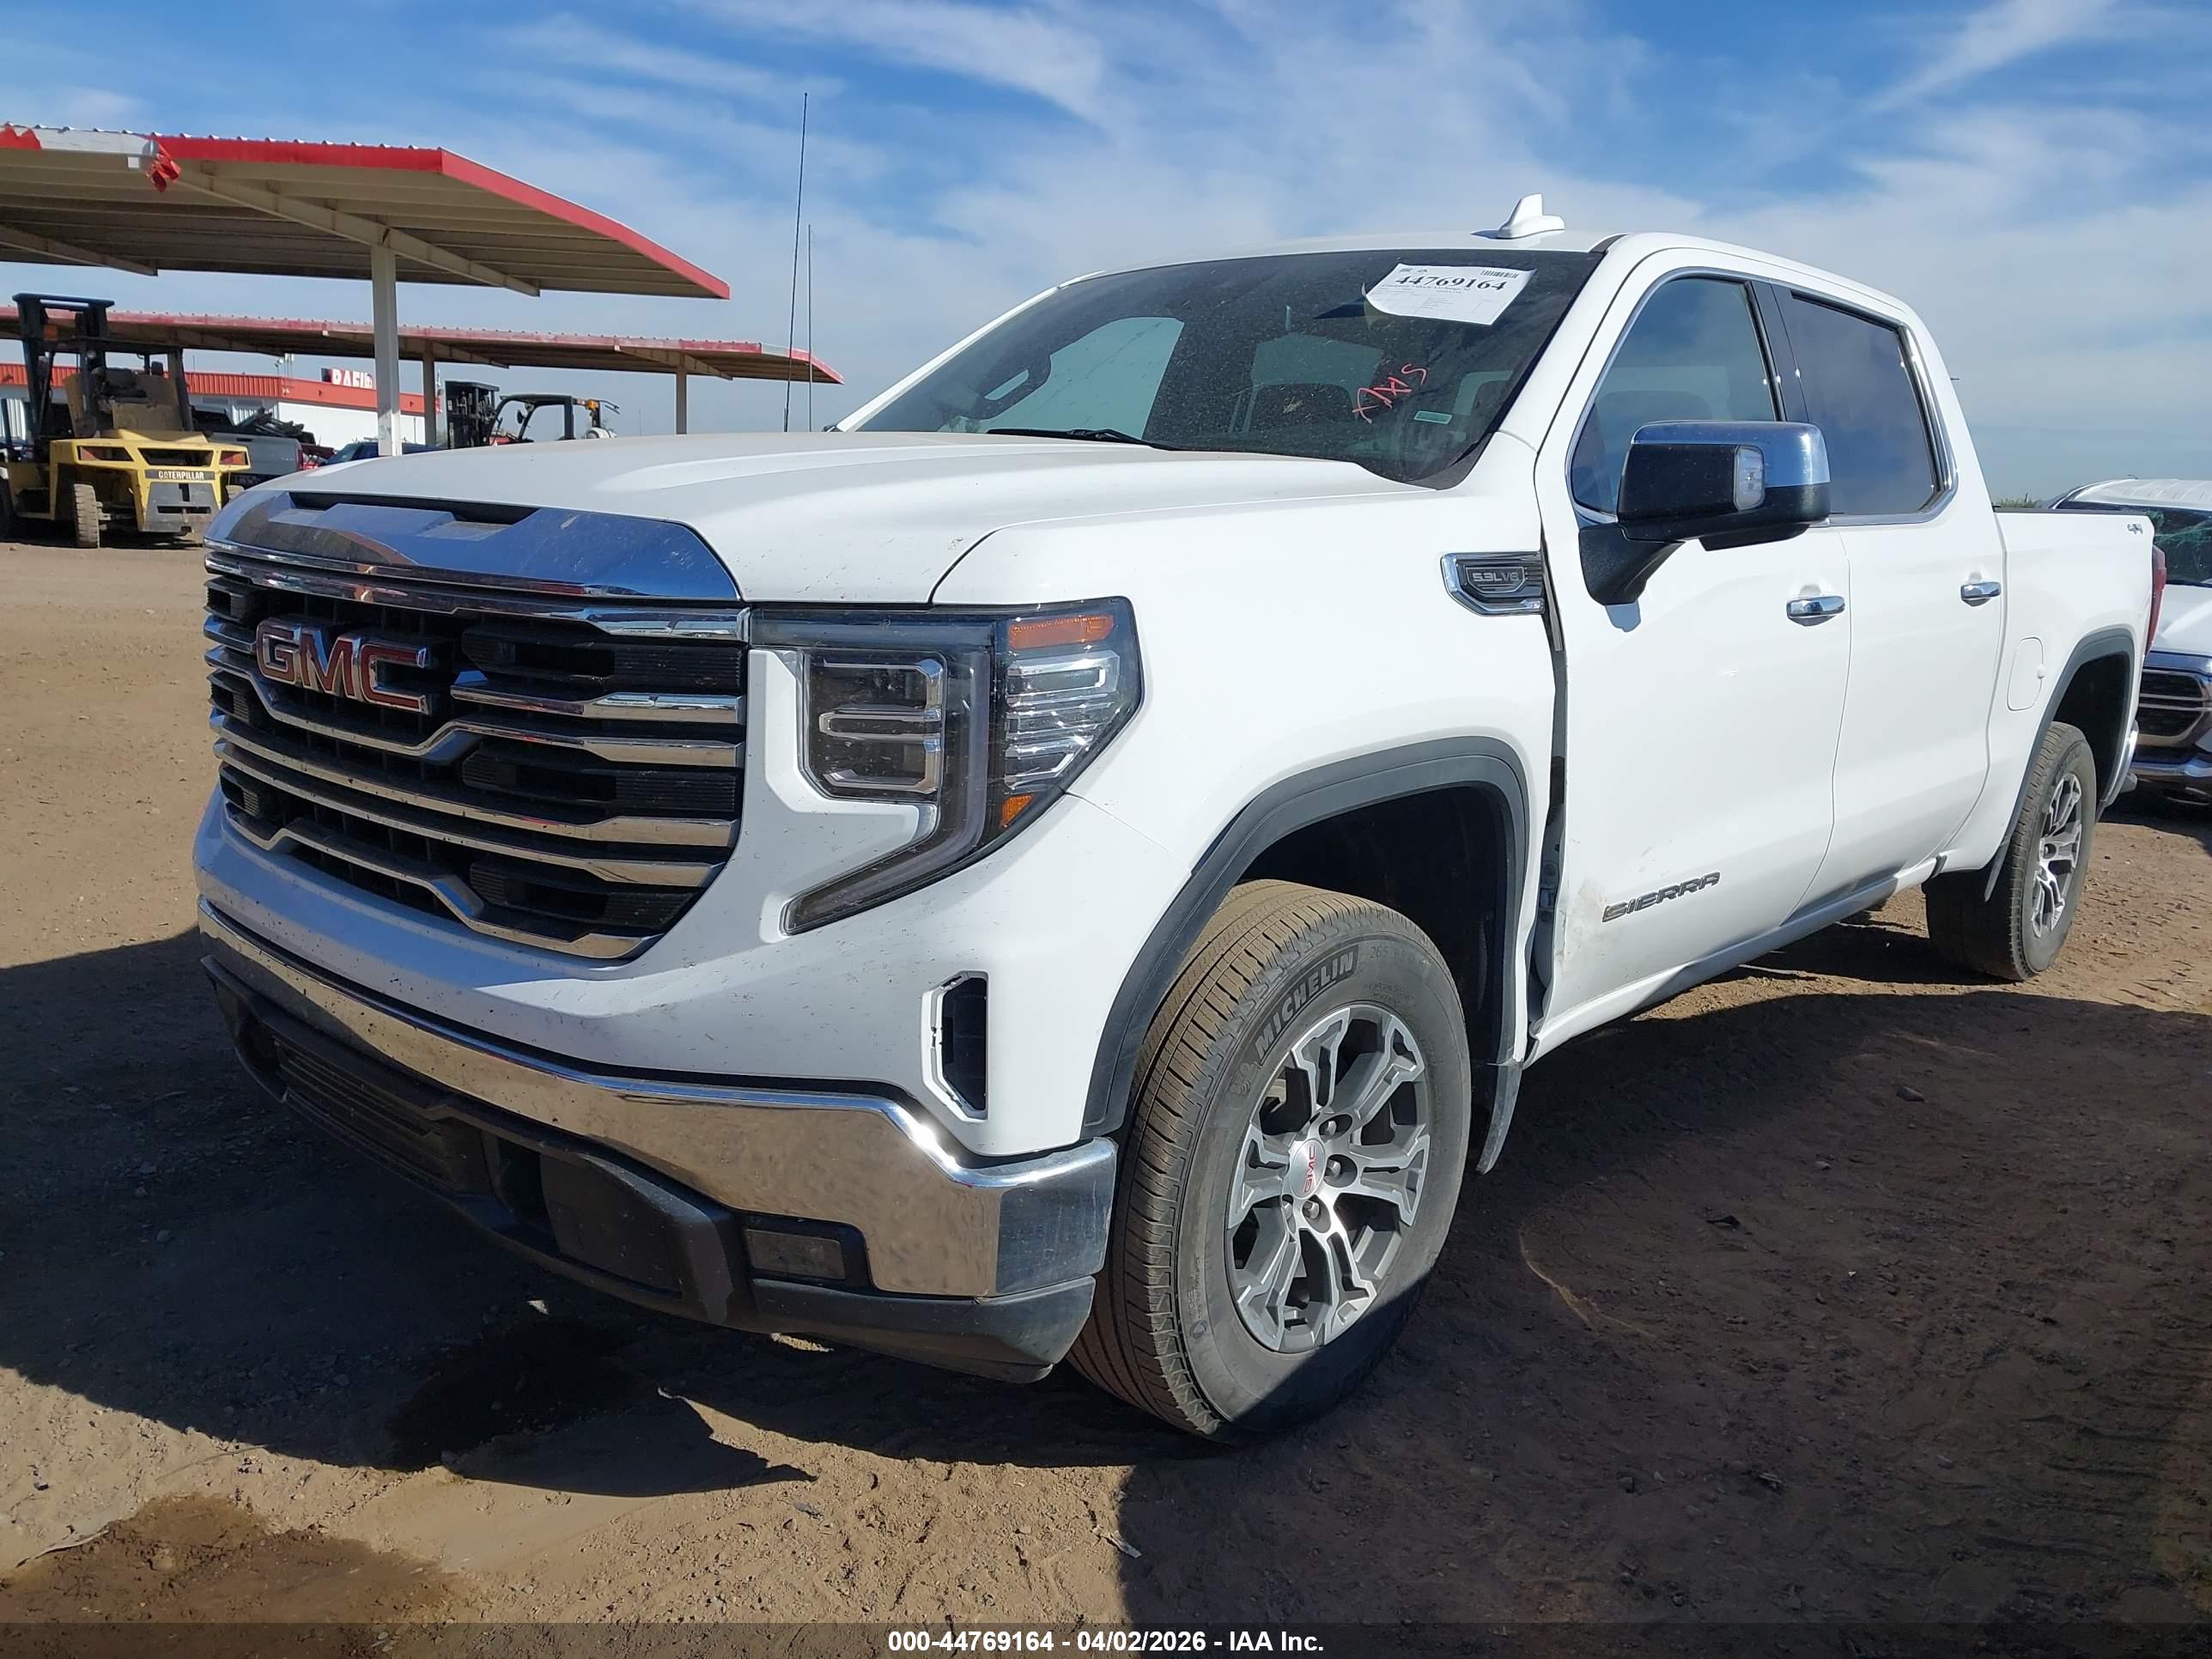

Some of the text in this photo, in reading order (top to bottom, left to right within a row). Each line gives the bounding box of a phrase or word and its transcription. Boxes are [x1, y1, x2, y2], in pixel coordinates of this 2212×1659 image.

[1395, 276, 1508, 291] 44769164
[256, 618, 432, 715] GMC
[1601, 871, 1721, 923] SIERRA
[1255, 951, 1354, 1060] MICHELIN
[1304, 1146, 1316, 1194] GMC
